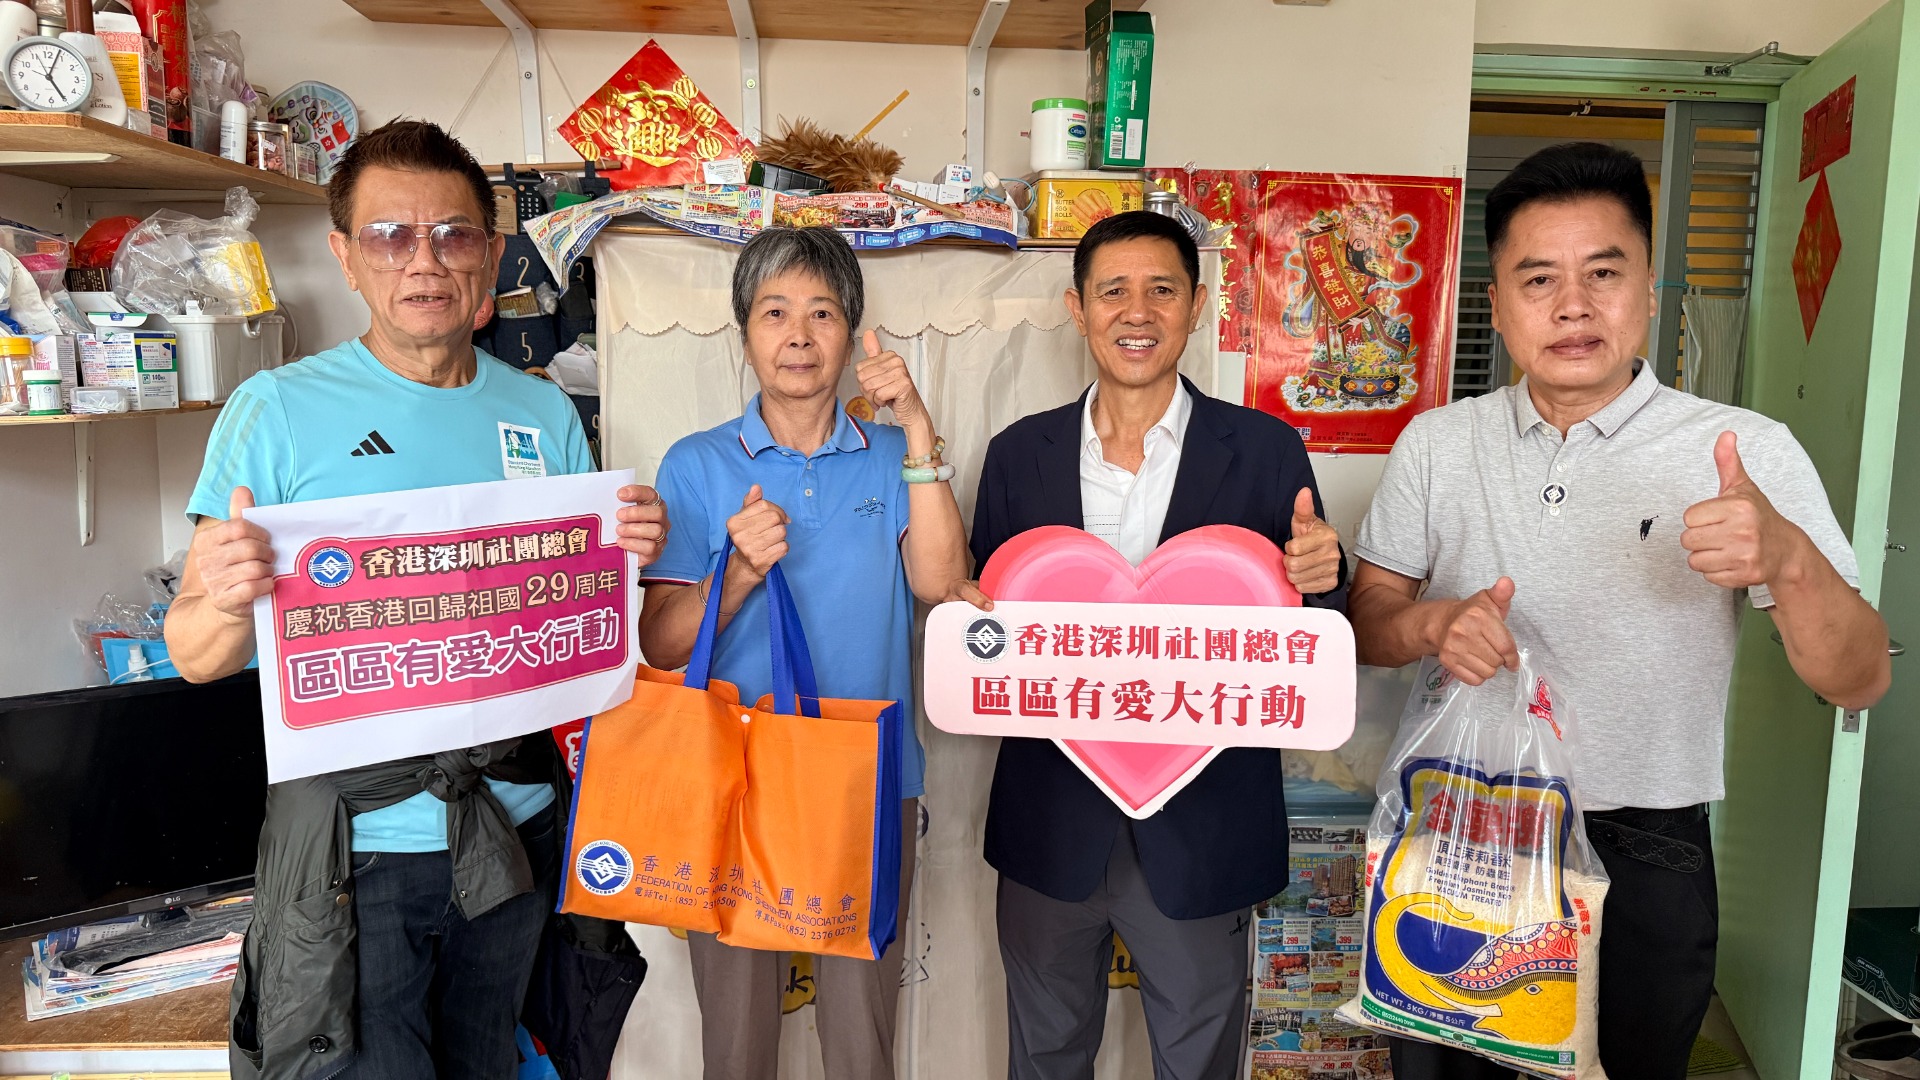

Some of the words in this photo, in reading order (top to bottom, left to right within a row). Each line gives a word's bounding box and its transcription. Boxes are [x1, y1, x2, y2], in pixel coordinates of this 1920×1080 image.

[22, 60, 30, 68] 10
[43, 50, 53, 59] 12
[18, 71, 24, 79] 9
[74, 76, 80, 84] 3
[517, 256, 531, 288] 2
[1311, 244, 1352, 310] 恭喜發財
[521, 332, 533, 362] 5
[361, 527, 590, 579] 香港深圳社團總會
[286, 606, 620, 704] 區區有愛大行動
[1014, 622, 1320, 665] 香港深圳社團總會
[971, 675, 1306, 729] 區區有愛大行動
[635, 873, 693, 894] FEDERATION
[695, 886, 710, 896] OF
[731, 885, 753, 901] KONG
[795, 912, 858, 927] ASSOCIATIONS
[785, 923, 807, 938] (852)
[1375, 989, 1389, 1001] NET
[1391, 996, 1405, 1008] WT.
[1407, 1003, 1424, 1015] 5KG
